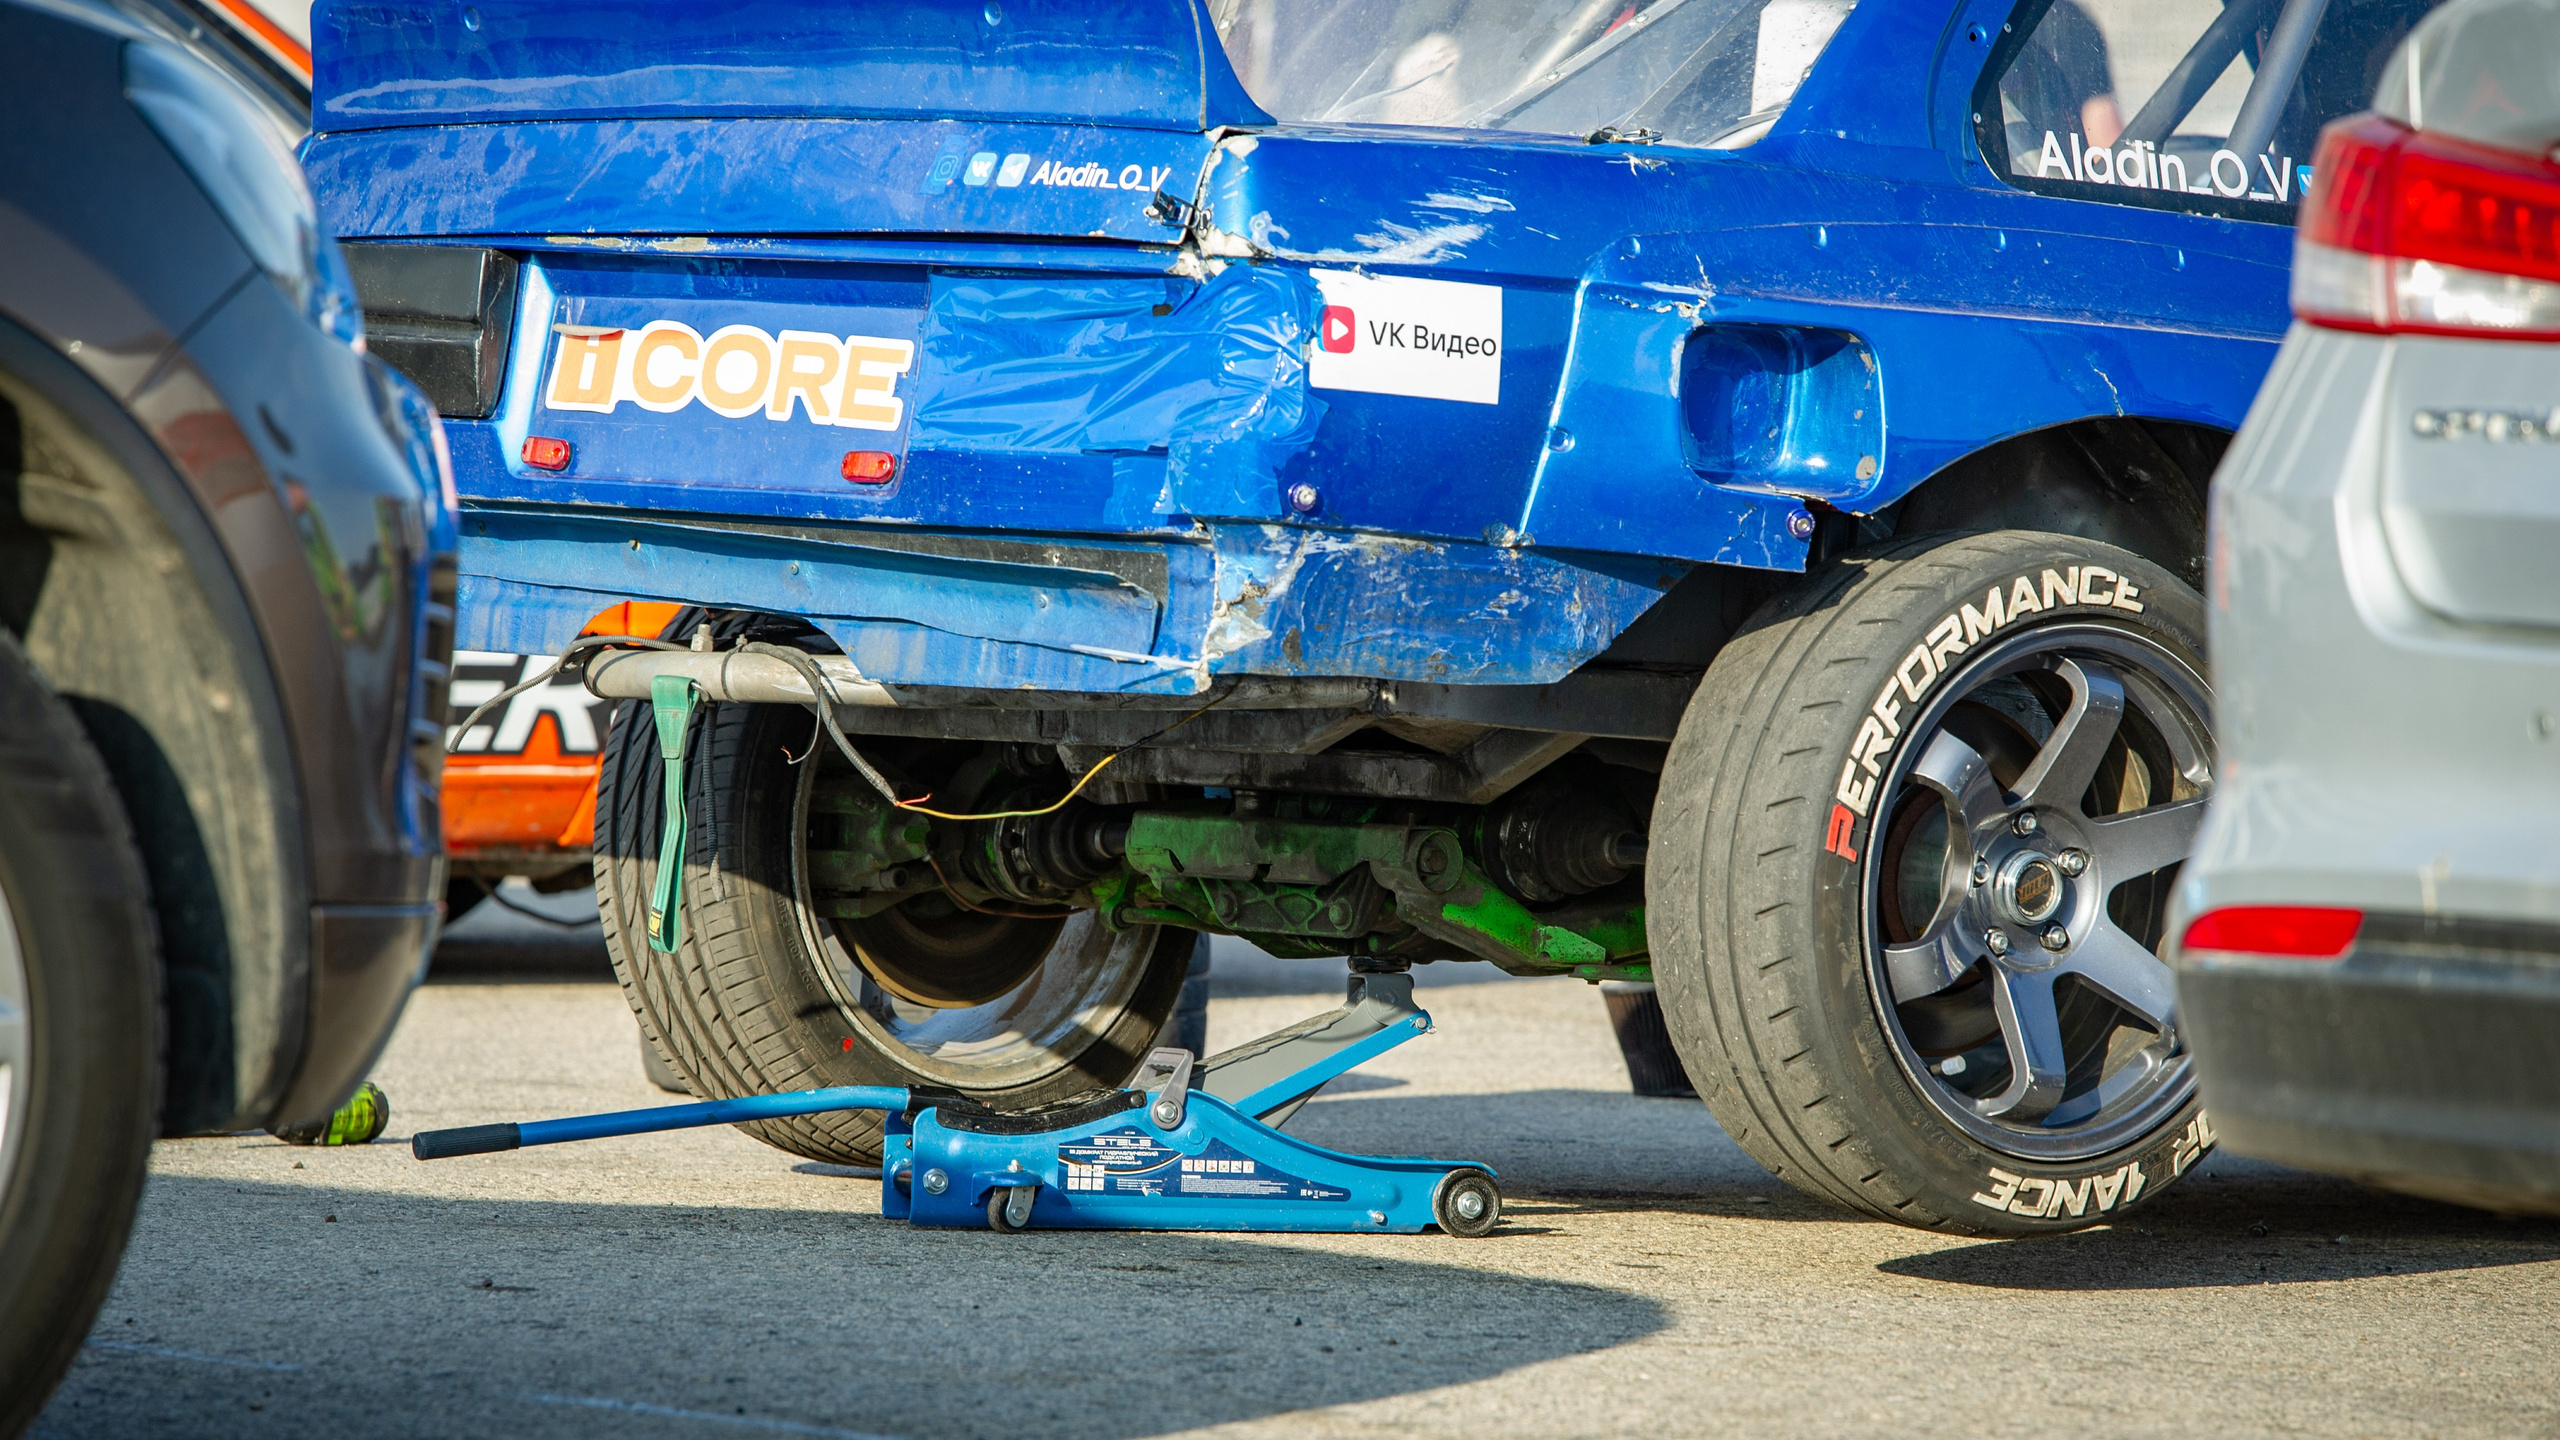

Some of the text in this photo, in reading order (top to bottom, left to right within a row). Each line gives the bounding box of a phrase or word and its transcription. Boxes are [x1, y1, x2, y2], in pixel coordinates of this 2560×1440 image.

[1029, 160, 1172, 192] Aladin_O_V
[2036, 130, 2292, 202] Aladin_O_V
[1369, 320, 1498, 359] VK Видео
[1825, 565, 2144, 864] PERFORMANCE
[1093, 1137, 1152, 1147] STELS
